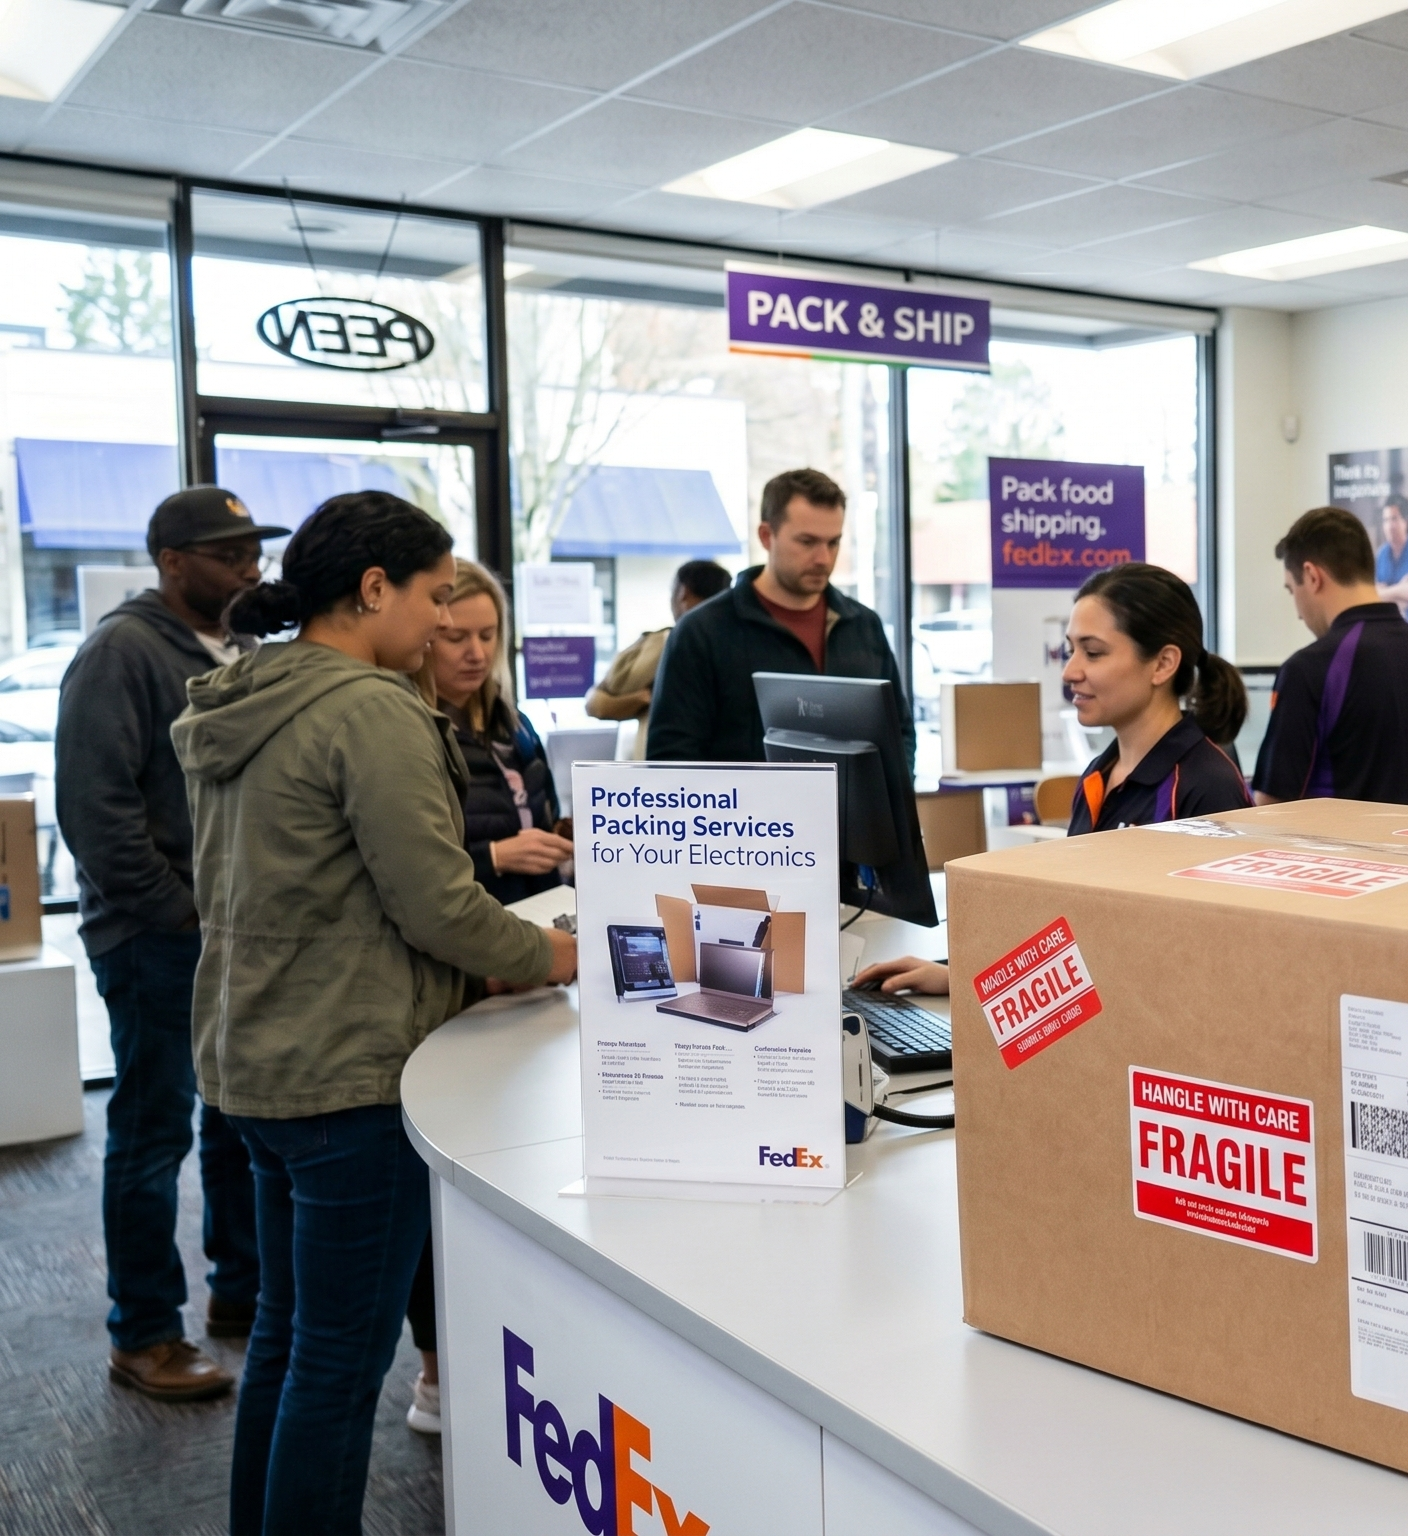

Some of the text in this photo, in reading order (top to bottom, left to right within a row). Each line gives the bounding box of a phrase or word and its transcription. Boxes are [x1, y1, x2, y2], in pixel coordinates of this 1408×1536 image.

[747, 290, 975, 346] PACK & SHIP
[1001, 475, 1114, 505] Pack food
[1001, 507, 1107, 541] shipping.
[591, 786, 738, 811] Professional
[591, 814, 795, 842] Packing Services
[591, 843, 817, 868] for Your Electronics
[1208, 858, 1402, 888] FRAGILE
[1038, 926, 1068, 954] CARE
[990, 954, 1084, 1036] FRAGILE
[1141, 1080, 1300, 1133] HANGLE WITH CARE
[758, 1145, 824, 1169] FedEx
[1138, 1119, 1308, 1208] FRAGILE
